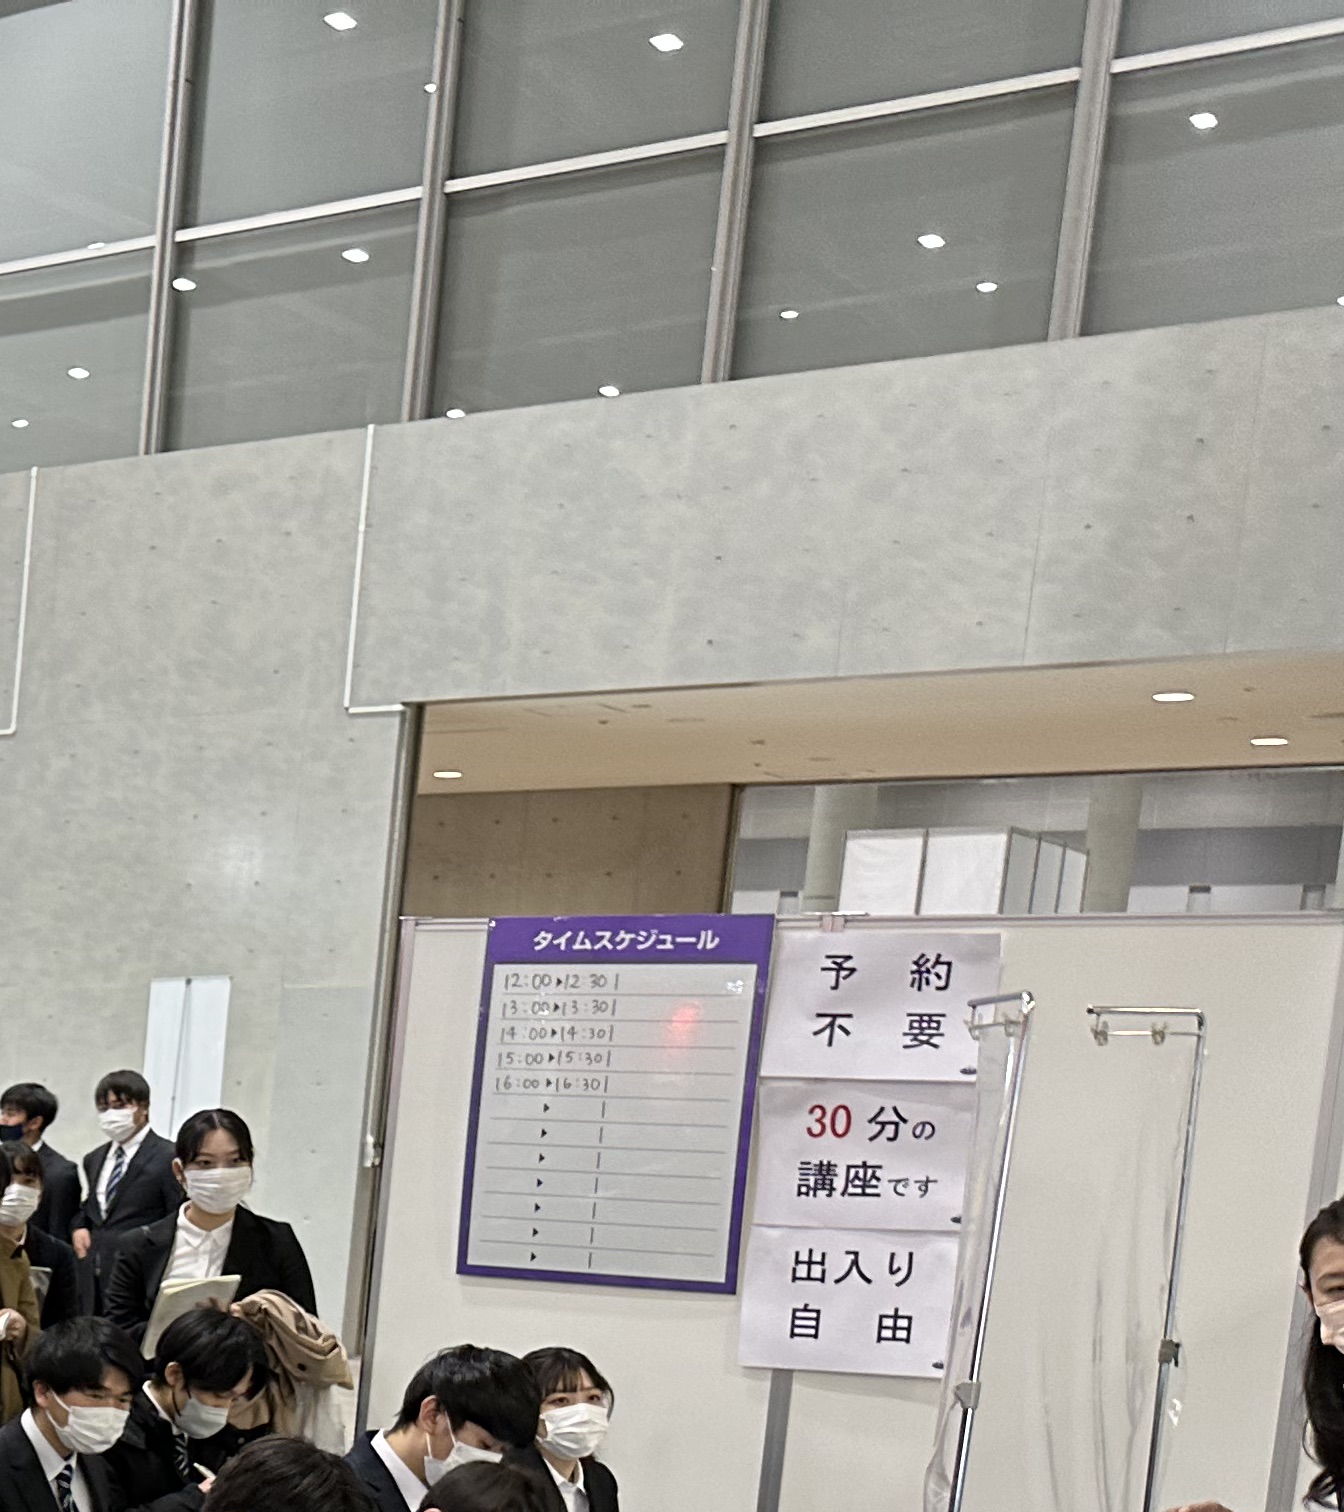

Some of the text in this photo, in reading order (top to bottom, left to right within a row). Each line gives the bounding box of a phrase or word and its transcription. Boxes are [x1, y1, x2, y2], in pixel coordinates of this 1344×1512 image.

[533, 929, 720, 951] タイムスケジュール
[796, 1160, 938, 1198] 講座です
[791, 1248, 914, 1287] 出入り
